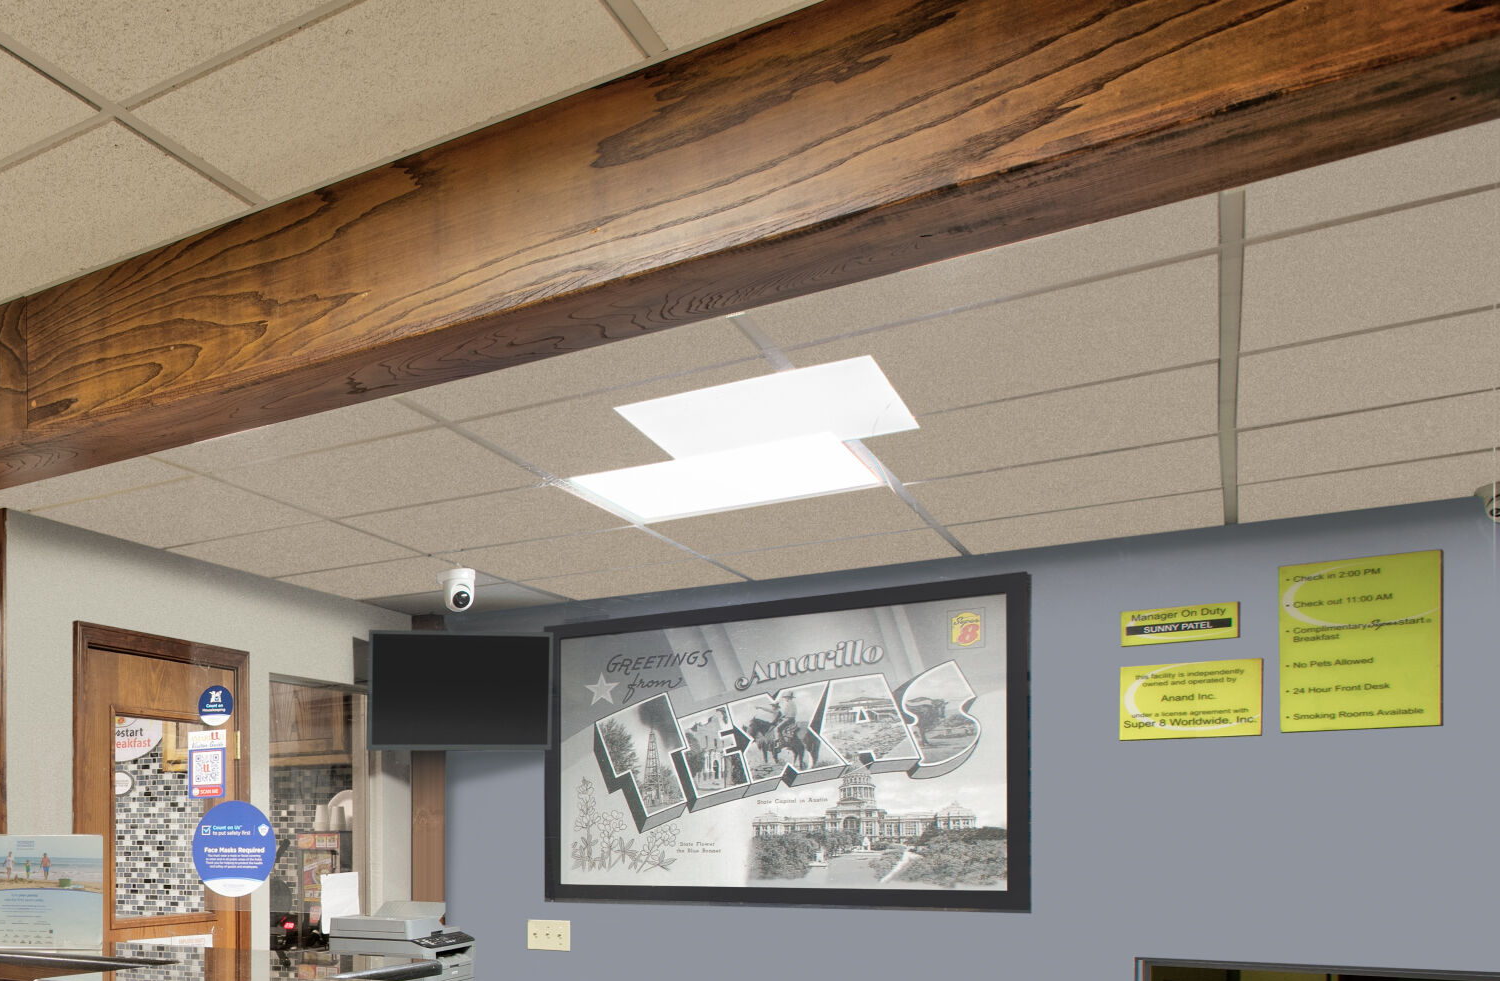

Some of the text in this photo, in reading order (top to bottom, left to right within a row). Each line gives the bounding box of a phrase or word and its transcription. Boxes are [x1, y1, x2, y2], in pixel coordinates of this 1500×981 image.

[1293, 574, 1324, 583] Check
[1339, 570, 1360, 578] 2:00
[1364, 568, 1381, 576] PM
[1293, 599, 1324, 608] Check
[1131, 607, 1226, 622] Manager On Duty
[957, 623, 979, 644] 8
[1143, 621, 1212, 634] SUNNY PATEL
[1293, 624, 1368, 635] Complimentary
[1293, 634, 1340, 643] Breakfast
[606, 650, 712, 673] GREETINGS
[734, 639, 884, 691] Amarillo
[1334, 657, 1374, 666] Allowed
[1151, 672, 1175, 680] facility
[1187, 668, 1244, 678] independently
[1142, 680, 1168, 688] owned
[1188, 677, 1224, 685] operated
[1227, 675, 1237, 683] by
[1308, 685, 1332, 693] Hour
[1364, 682, 1390, 690] Desk
[623, 673, 684, 705] from
[1161, 692, 1216, 702] Anand Inc.
[1190, 709, 1231, 717] agreement
[1293, 711, 1336, 721] Smoking
[1376, 707, 1424, 716] Available
[1124, 720, 1155, 730] Super
[1237, 715, 1257, 723] Inc.
[594, 659, 982, 834] TEXAS
